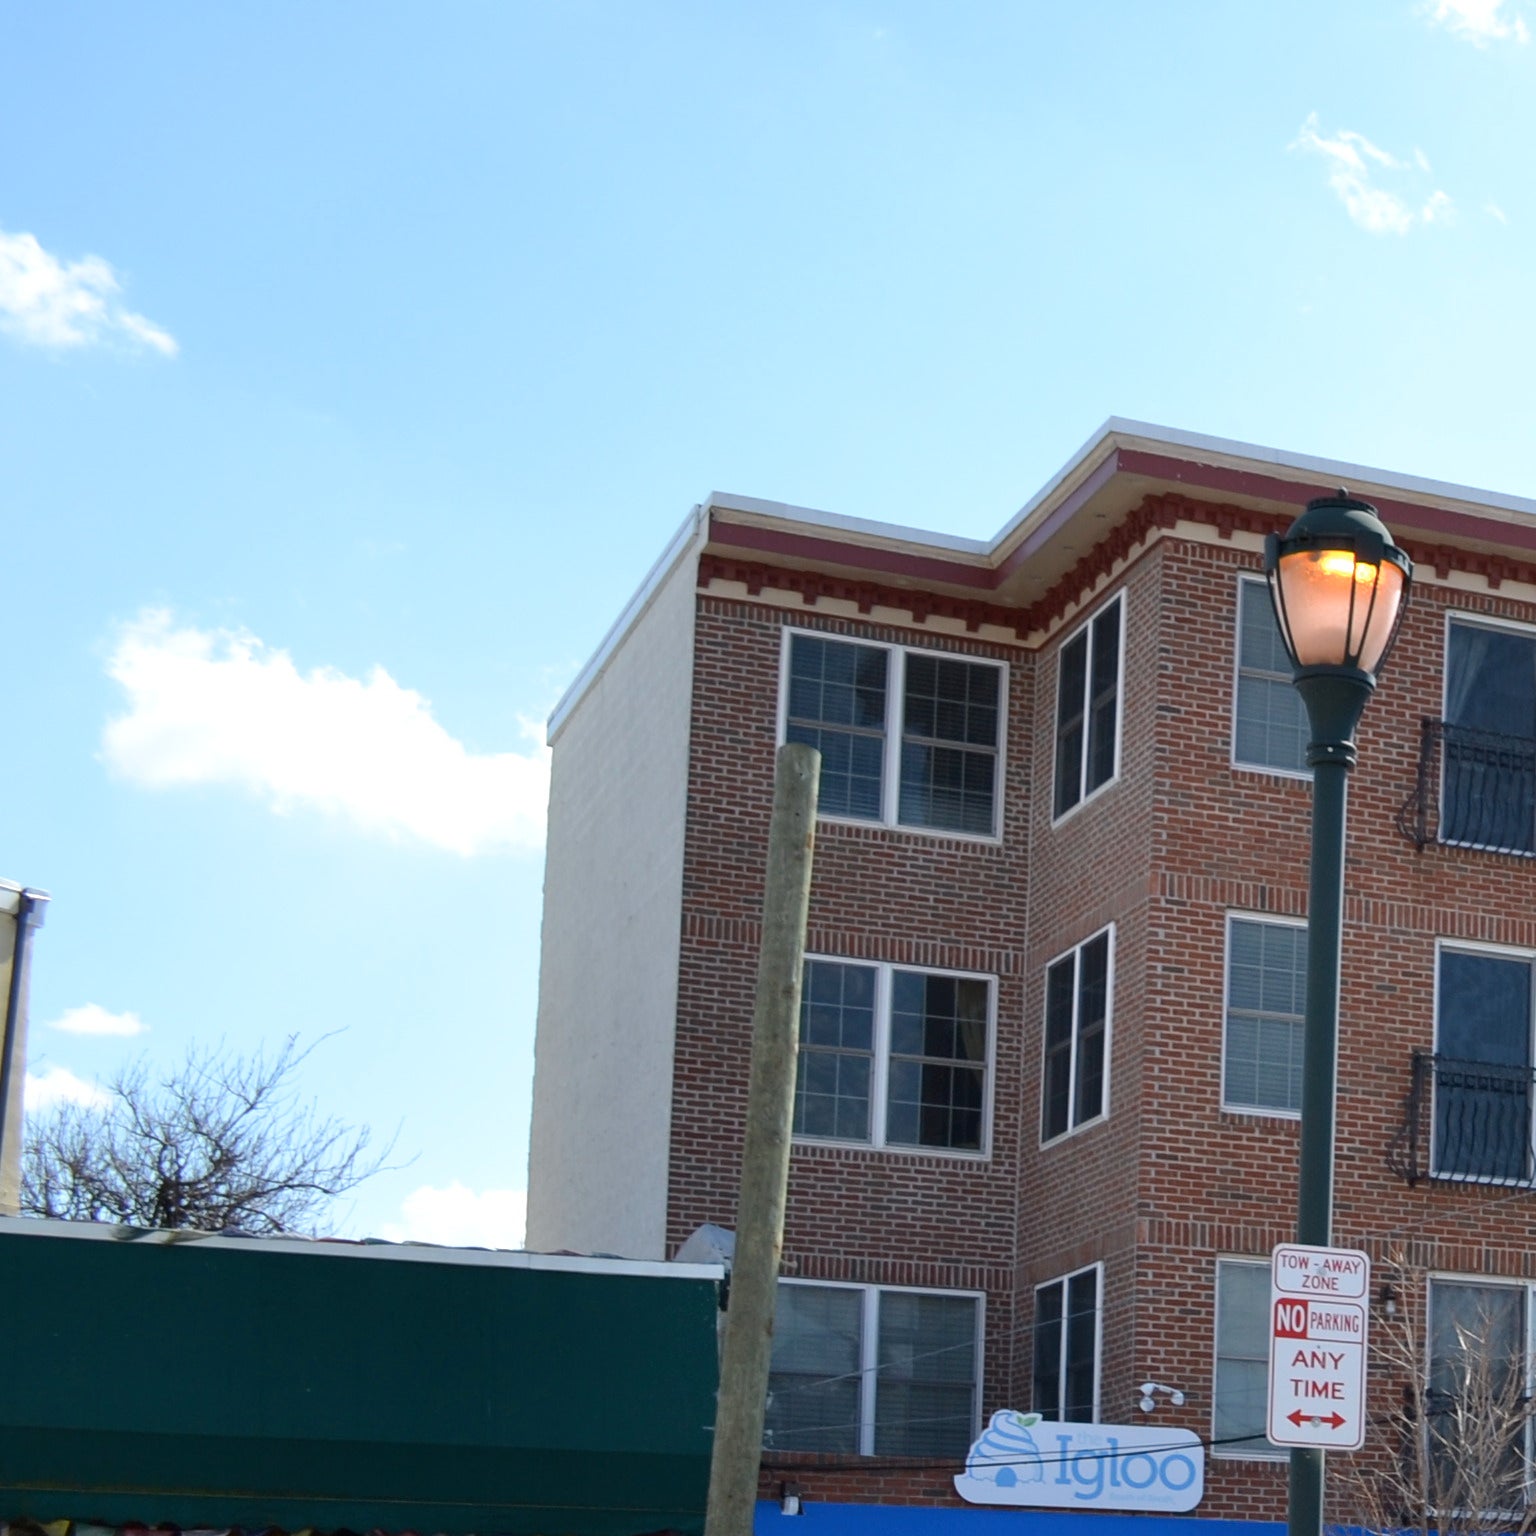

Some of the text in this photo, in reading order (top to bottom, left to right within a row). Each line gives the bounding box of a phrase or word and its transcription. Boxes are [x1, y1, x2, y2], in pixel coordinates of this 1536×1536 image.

[1280, 1254, 1309, 1269] TOW
[1323, 1258, 1361, 1275] AWAY
[1302, 1274, 1339, 1290] ZONE
[1276, 1303, 1360, 1333] NO PARKING
[1291, 1349, 1345, 1370] ANY
[1289, 1378, 1345, 1400] TIME
[1055, 1434, 1197, 1500] Igloo
